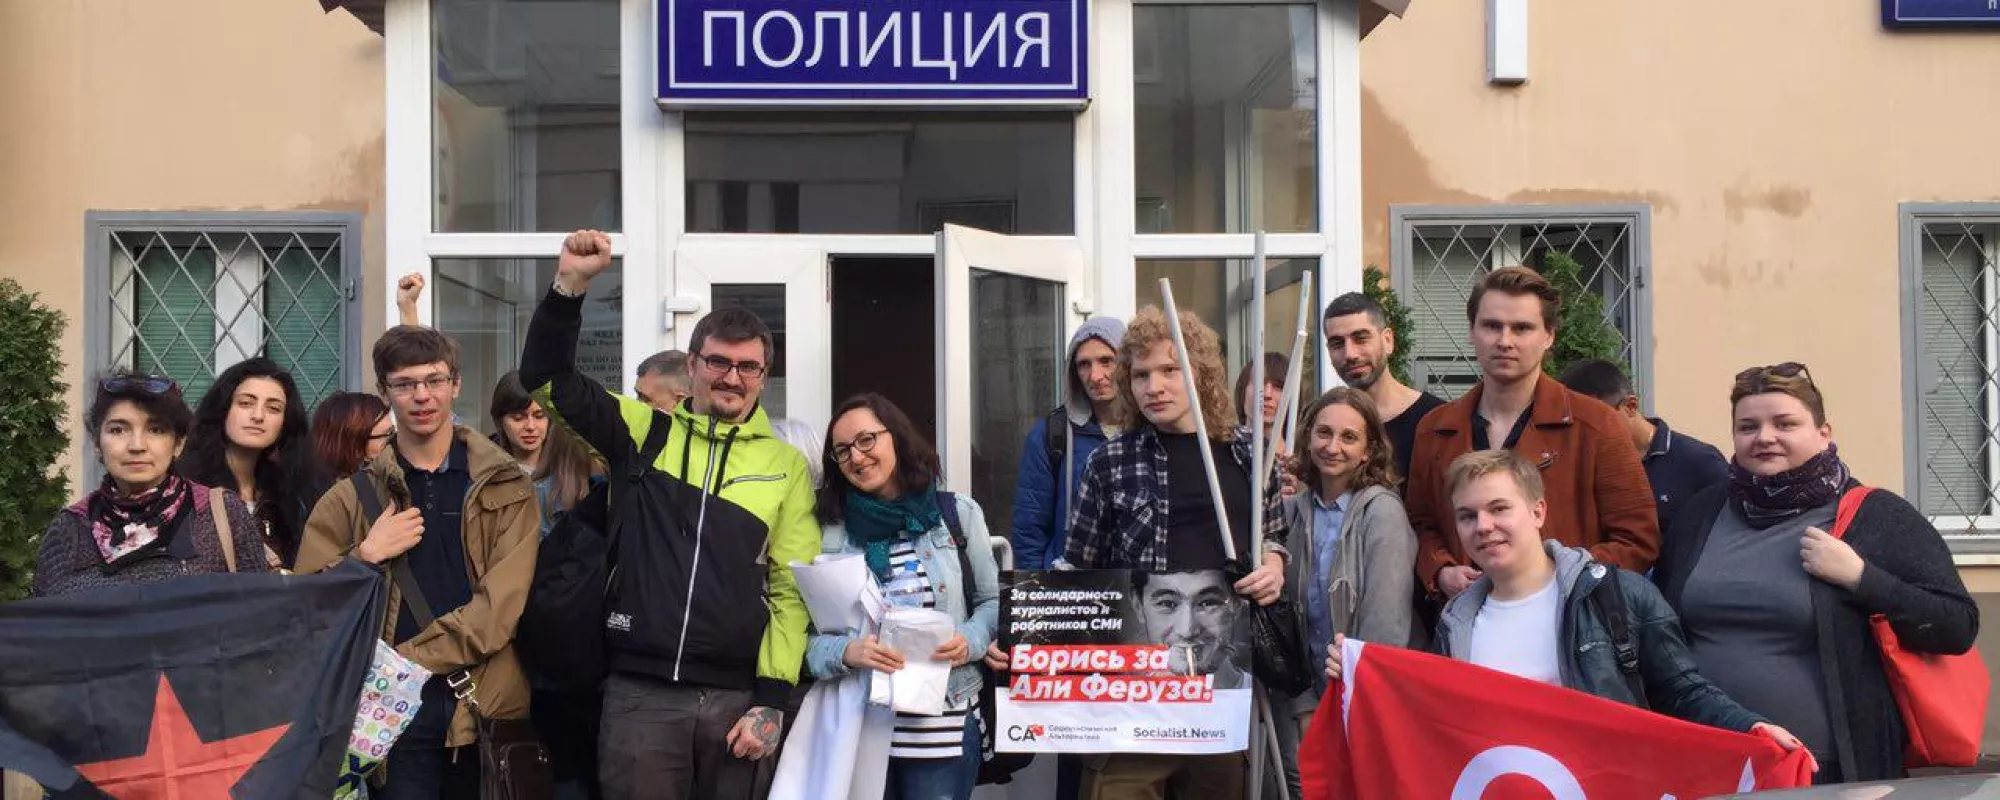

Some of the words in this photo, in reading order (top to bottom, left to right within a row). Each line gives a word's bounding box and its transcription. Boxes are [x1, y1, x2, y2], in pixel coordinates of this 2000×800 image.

[703, 10, 1051, 81] ПОЛИЦИЯ
[1010, 589, 1027, 600] За
[1029, 590, 1123, 602] солидарность
[1010, 605, 1098, 617] журналистов
[1101, 606, 1110, 615] и
[1010, 619, 1088, 633] работников
[1091, 618, 1123, 630] СМИ
[1010, 643, 1126, 676] Борись
[1132, 650, 1169, 670] за
[1009, 674, 1073, 699] Али
[1080, 672, 1214, 702] Феруза!
